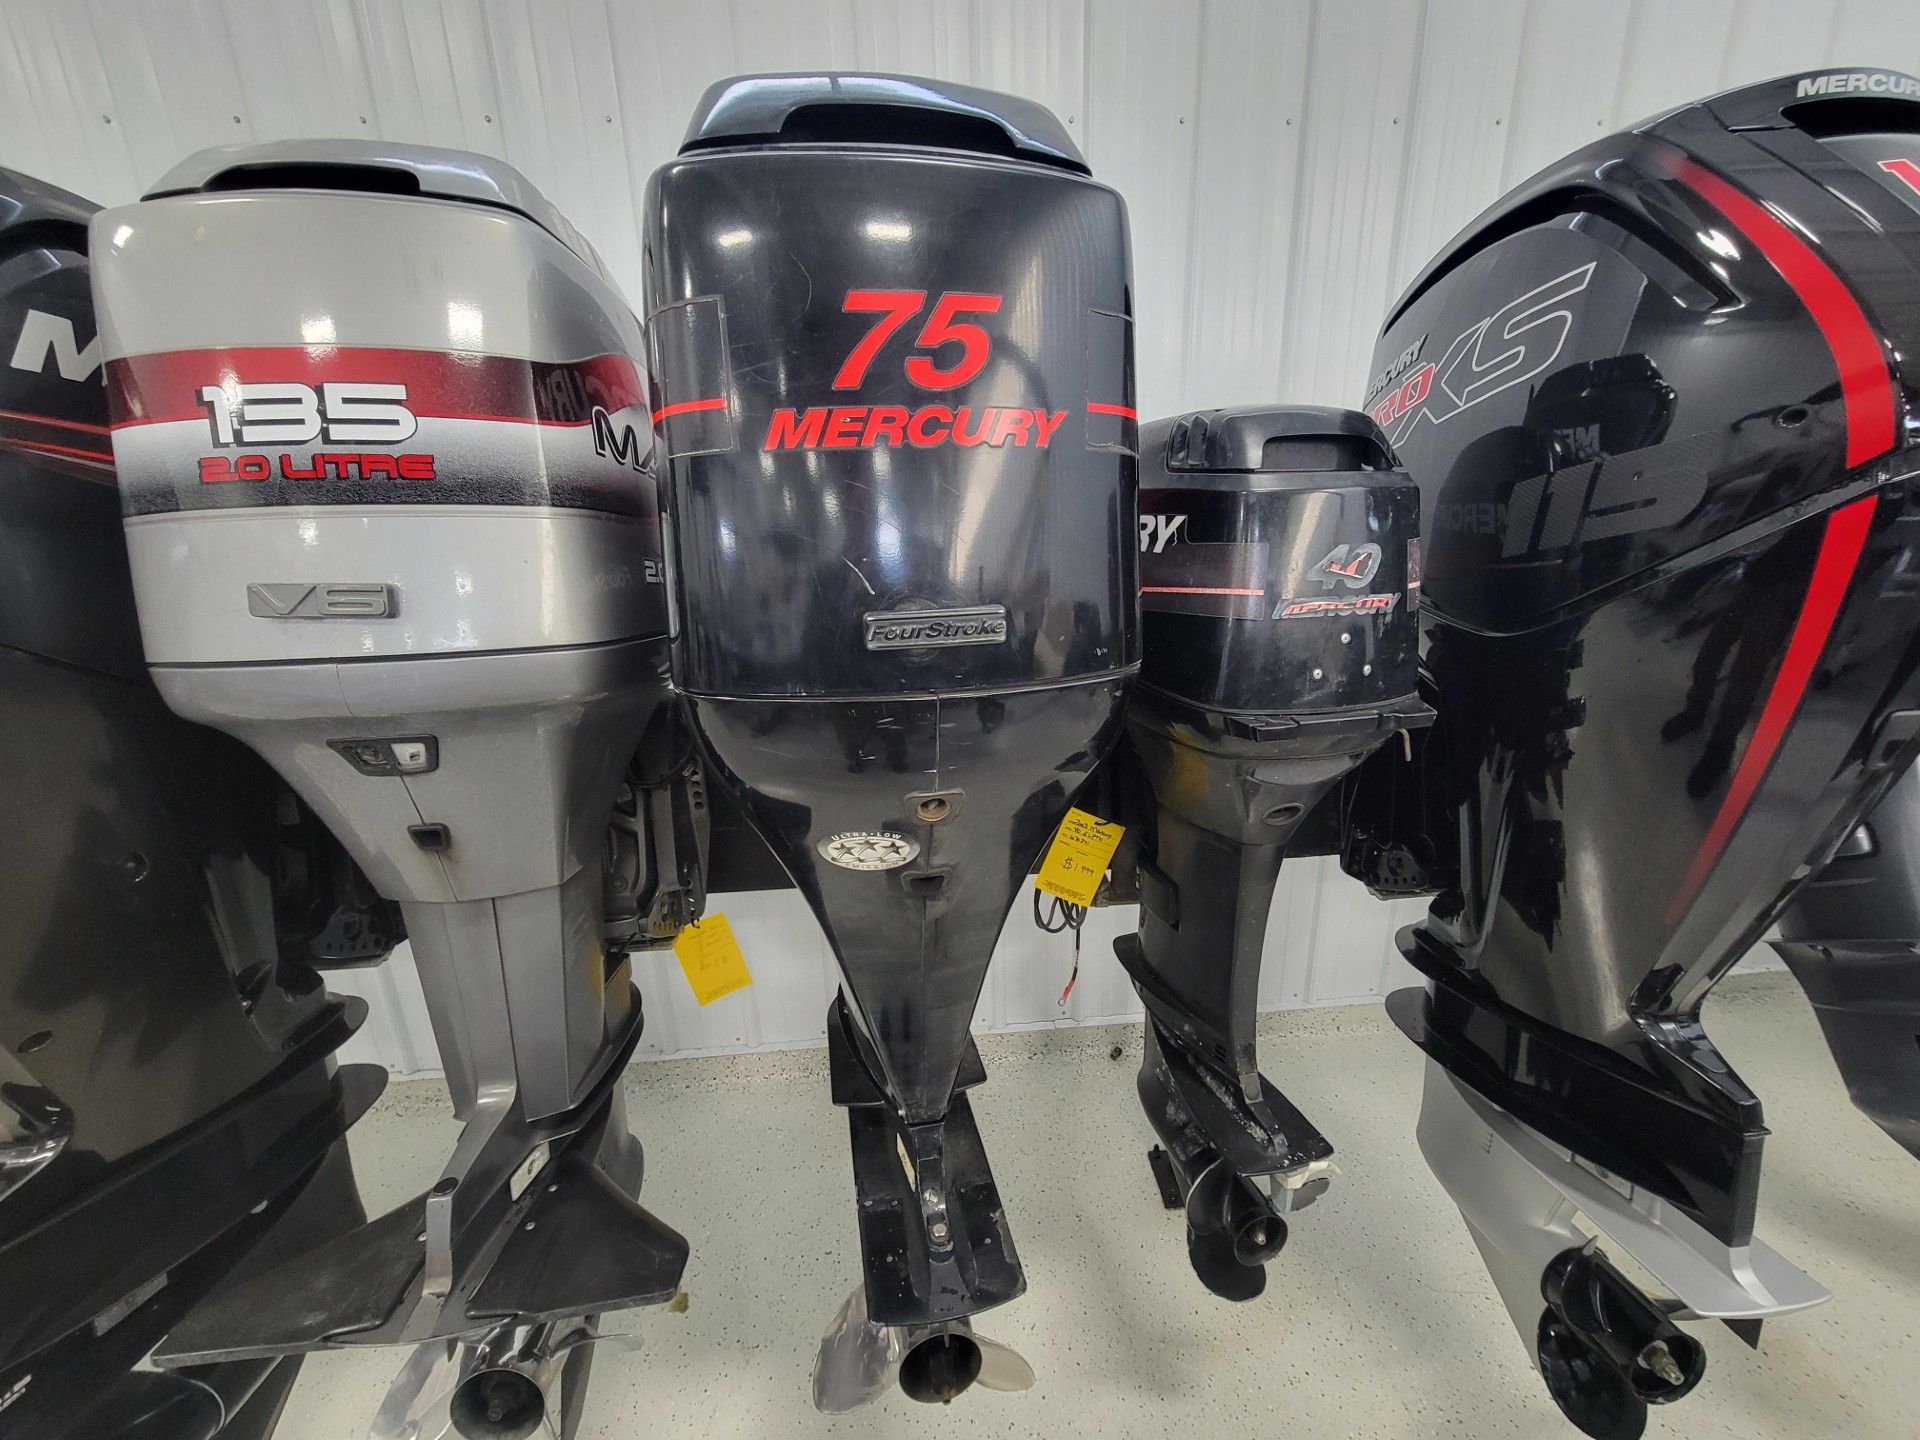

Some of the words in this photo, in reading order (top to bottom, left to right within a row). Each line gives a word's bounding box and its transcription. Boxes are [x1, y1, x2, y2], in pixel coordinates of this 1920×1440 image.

[832, 289, 1003, 391] 75
[198, 382, 418, 448] 135
[764, 407, 1069, 450] MERCURY
[197, 454, 271, 485] 2.0
[279, 453, 437, 482] LITRE
[1306, 542, 1382, 590] 40
[248, 583, 389, 617] V6
[868, 619, 1005, 641] FourStroke
